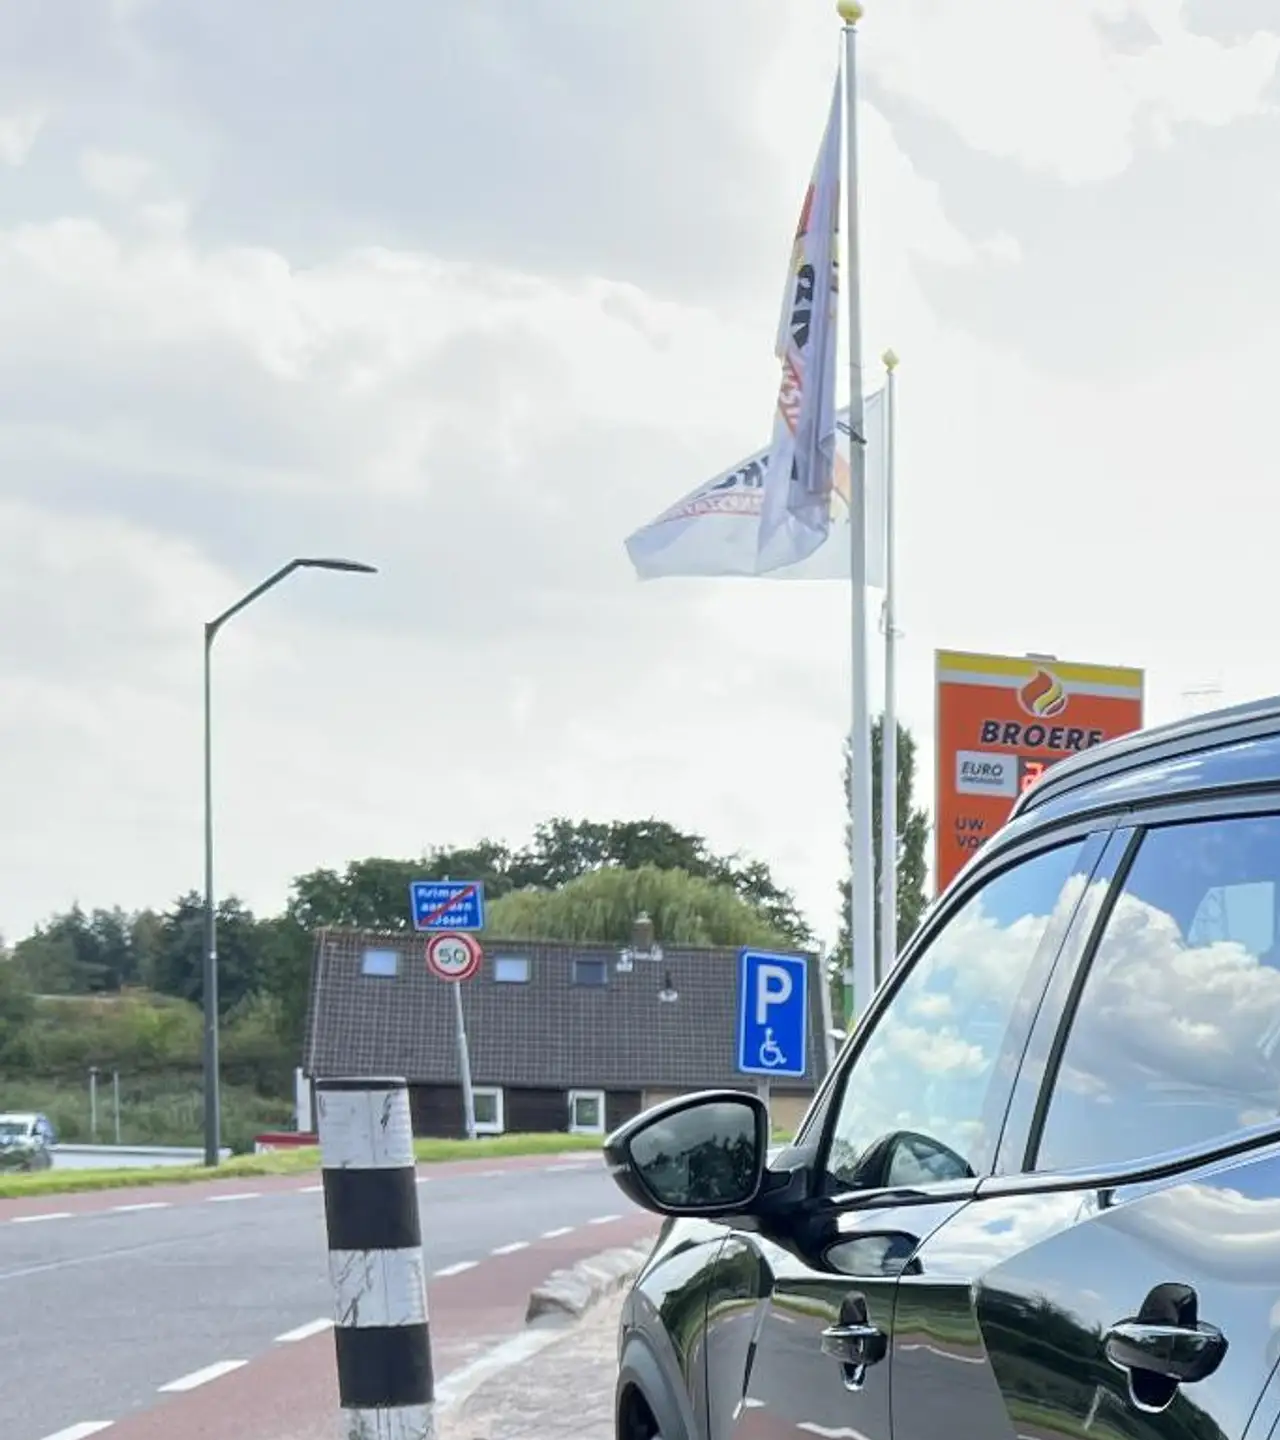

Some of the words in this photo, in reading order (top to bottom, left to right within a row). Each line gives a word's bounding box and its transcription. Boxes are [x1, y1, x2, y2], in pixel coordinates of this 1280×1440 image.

[960, 761, 1004, 777] EURO
[954, 816, 984, 831] UW
[438, 947, 466, 965] 50
[756, 964, 792, 1025] P
